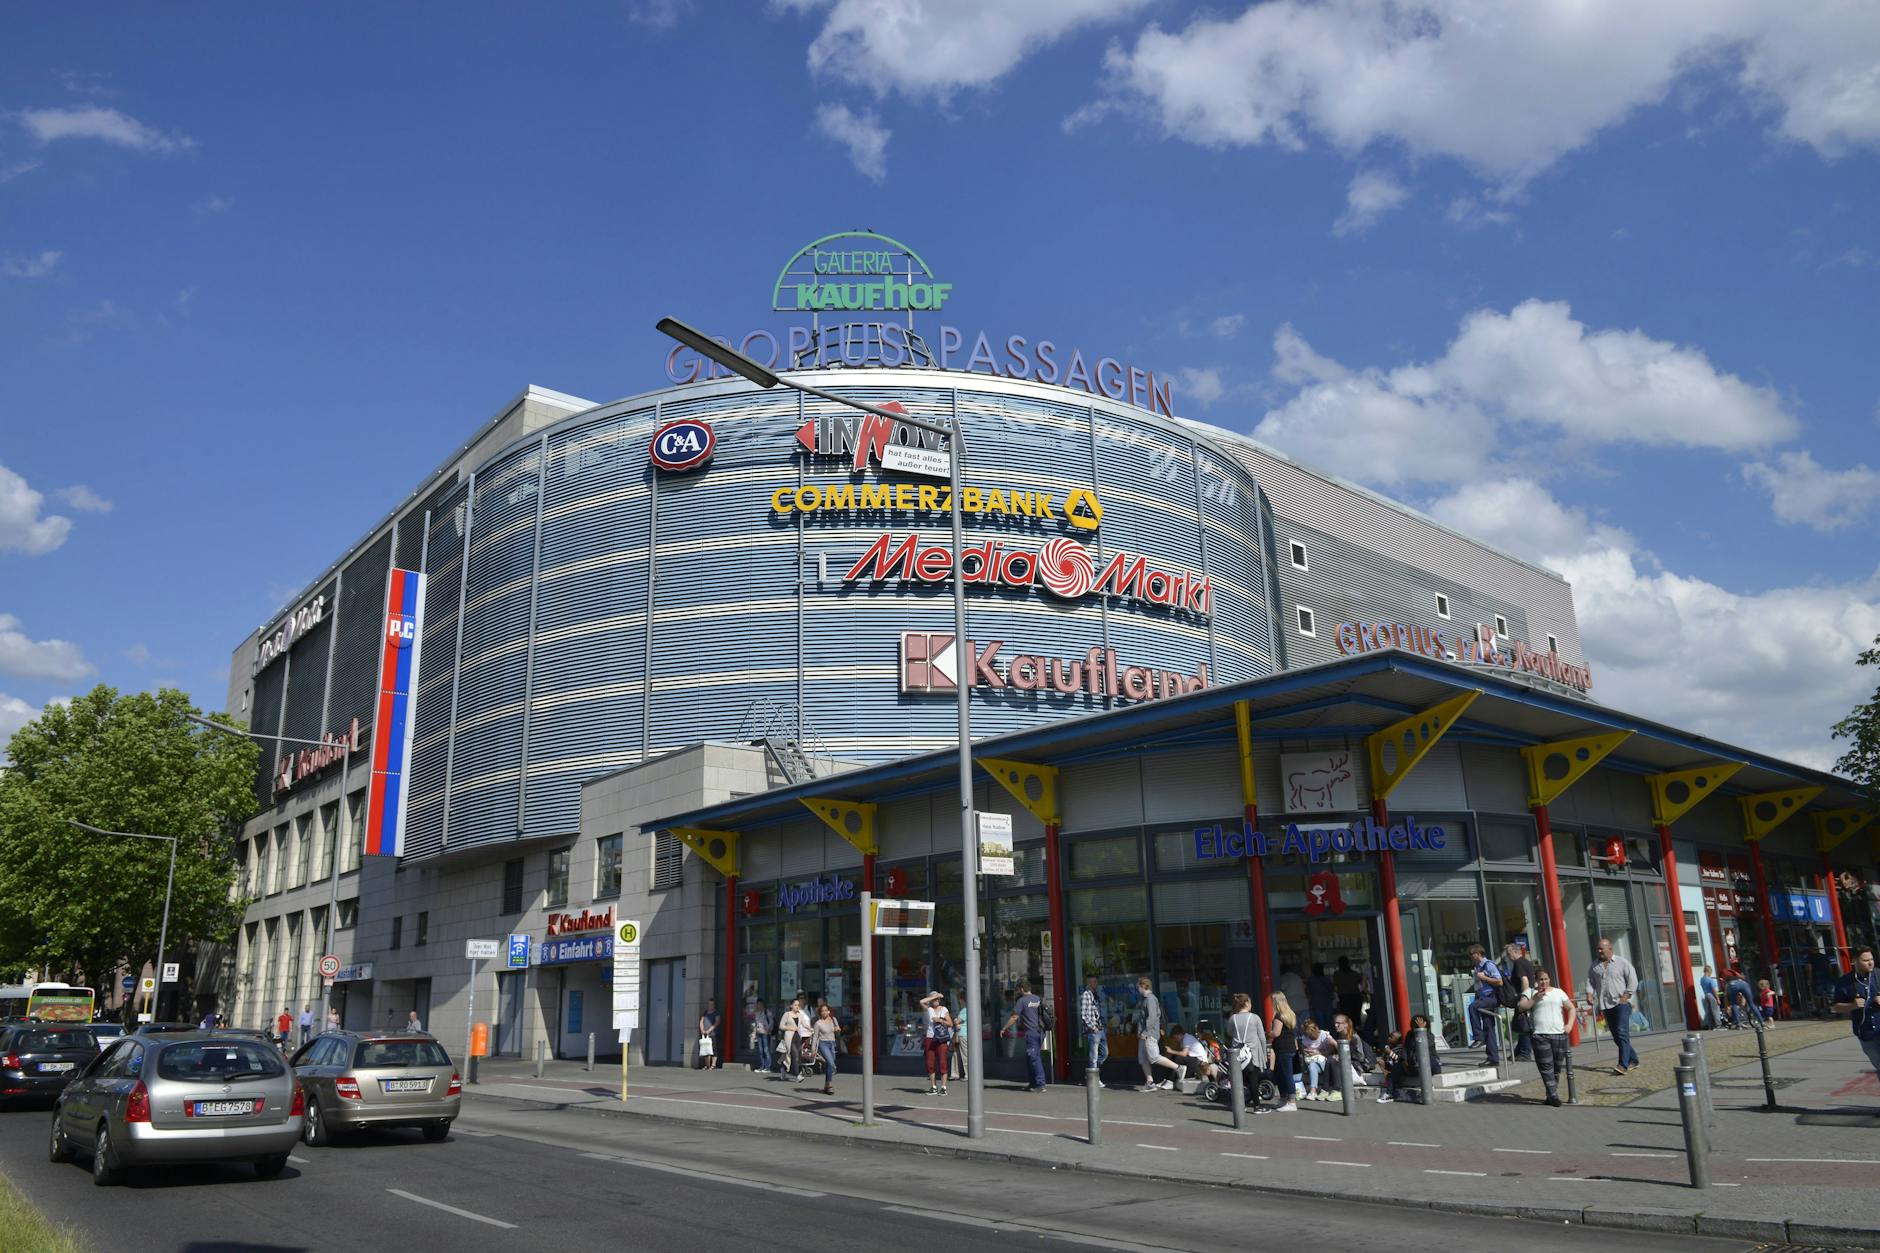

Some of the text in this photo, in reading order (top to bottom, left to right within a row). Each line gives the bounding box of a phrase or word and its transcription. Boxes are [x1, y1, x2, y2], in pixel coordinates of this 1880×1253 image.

[815, 251, 893, 274] GALERIA
[940, 325, 1174, 418] PASSAGEN
[661, 430, 702, 455] C&A
[888, 449, 902, 457] hat
[904, 452, 920, 460] fast
[922, 455, 942, 464] alles
[897, 460, 950, 474] außer teuer!
[771, 483, 1055, 519] COMMERZBANK
[842, 532, 1213, 614] Media Markt
[1335, 621, 1448, 659] GROPIUS
[965, 638, 1209, 700] Kaufland
[1193, 815, 1447, 863] Elch-Apotheke
[778, 873, 854, 913] Apotheke
[560, 906, 614, 933] Kaufland
[624, 928, 633, 939] H
[559, 940, 594, 960] Einfahrt
[324, 961, 336, 971] 50
[201, 1103, 208, 1113] B
